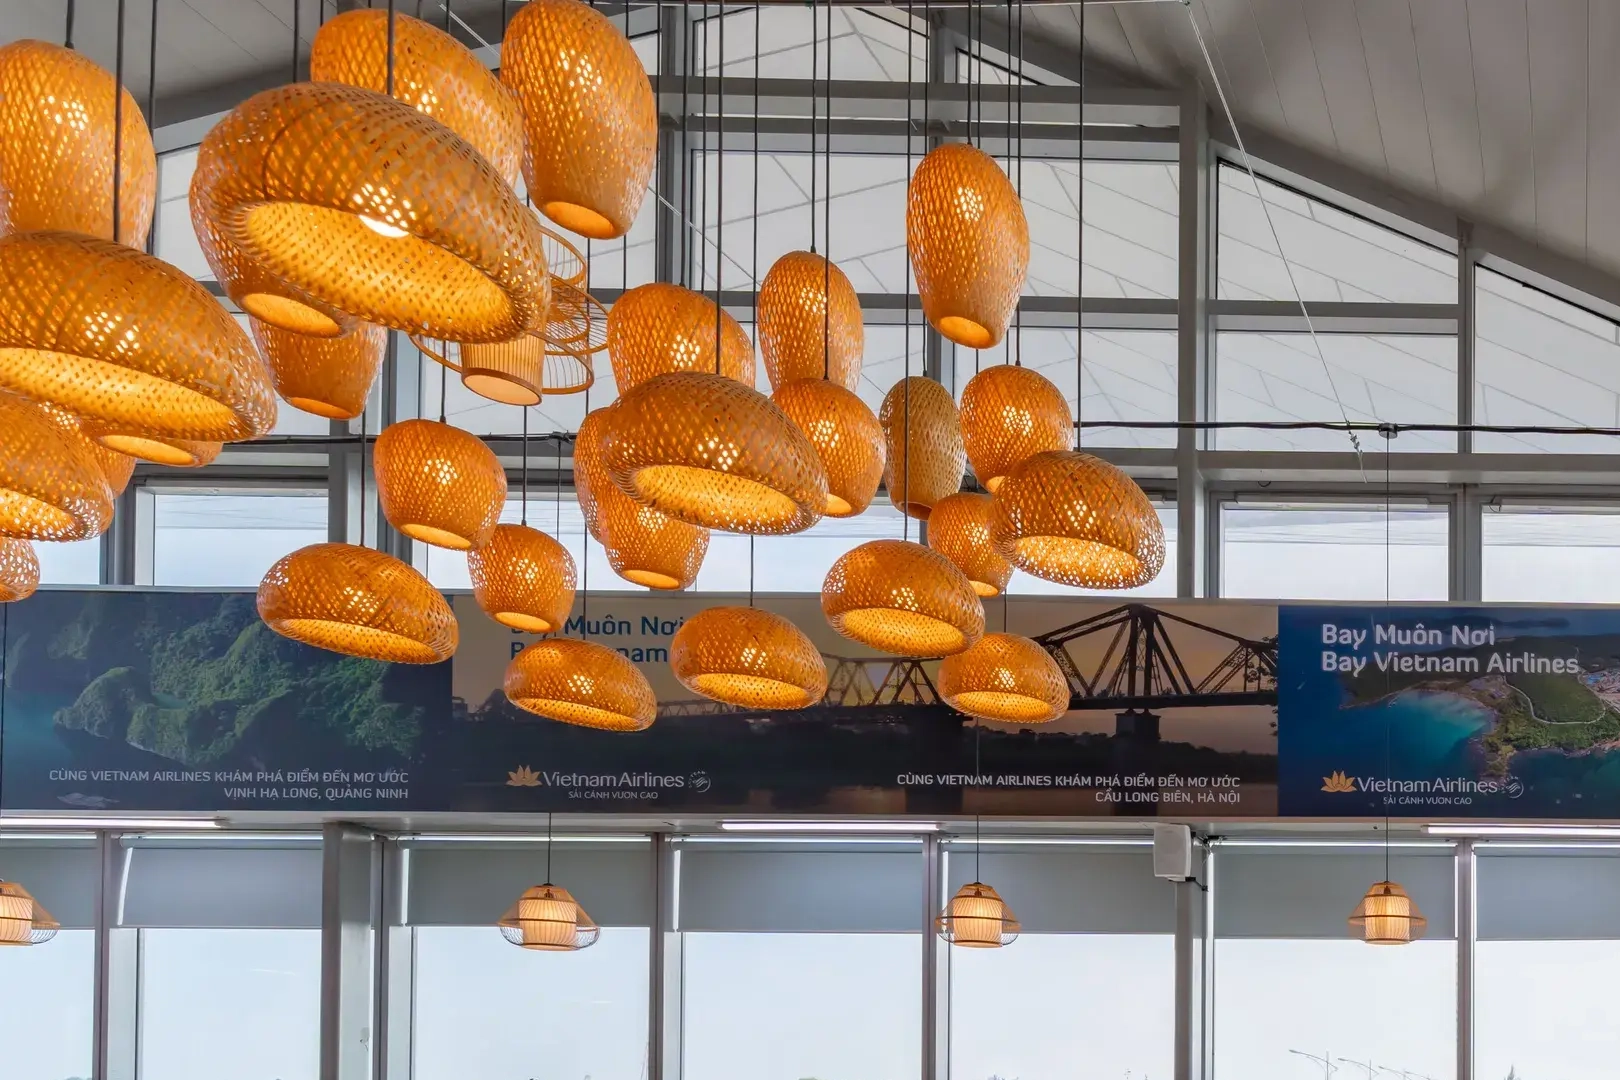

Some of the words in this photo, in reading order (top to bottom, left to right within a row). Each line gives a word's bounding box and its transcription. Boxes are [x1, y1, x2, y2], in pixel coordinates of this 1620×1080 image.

[1321, 624, 1367, 650] Bay
[1375, 624, 1443, 645] Muôn
[1451, 624, 1496, 645] Nơi
[1321, 651, 1367, 677] Bay
[1374, 651, 1480, 673] Vietnam
[1486, 652, 1580, 674] Airlines
[49, 768, 88, 782] CÙNG
[91, 769, 150, 782] VIETNAM
[153, 770, 211, 783] AIRLINES
[214, 769, 254, 783] KHÁM
[257, 769, 285, 783] PHÁ
[287, 766, 320, 783] ĐIỂM
[323, 768, 351, 784] ĐẾN
[354, 771, 376, 784] MƠ
[379, 768, 409, 784] ƯỚC
[897, 772, 934, 786] CÙNG
[936, 775, 993, 786] VIETNAM
[996, 775, 1052, 786] AIRLINES
[1055, 773, 1092, 787] KHÁM
[1095, 773, 1121, 787] PHÁ
[1124, 771, 1155, 788] ĐIỂM
[1158, 773, 1185, 788] ĐẾN
[1188, 776, 1209, 788] MƠ
[1211, 774, 1241, 788] ƯỚC
[224, 787, 256, 800] VỊNH
[260, 788, 279, 800] HẠ
[282, 788, 322, 800] LONG,
[325, 785, 373, 801] QUẢNG
[376, 788, 409, 799] NINH
[584, 790, 610, 799] CÁNH
[639, 791, 659, 800] CAO
[1095, 788, 1122, 803] CẦU
[1125, 792, 1159, 803] LONG
[1163, 790, 1195, 804] BIÊN,
[1198, 789, 1216, 803] HÀ
[1218, 790, 1241, 805] NỘI
[1398, 795, 1424, 805] CÁNH
[1453, 797, 1472, 805] CAO
